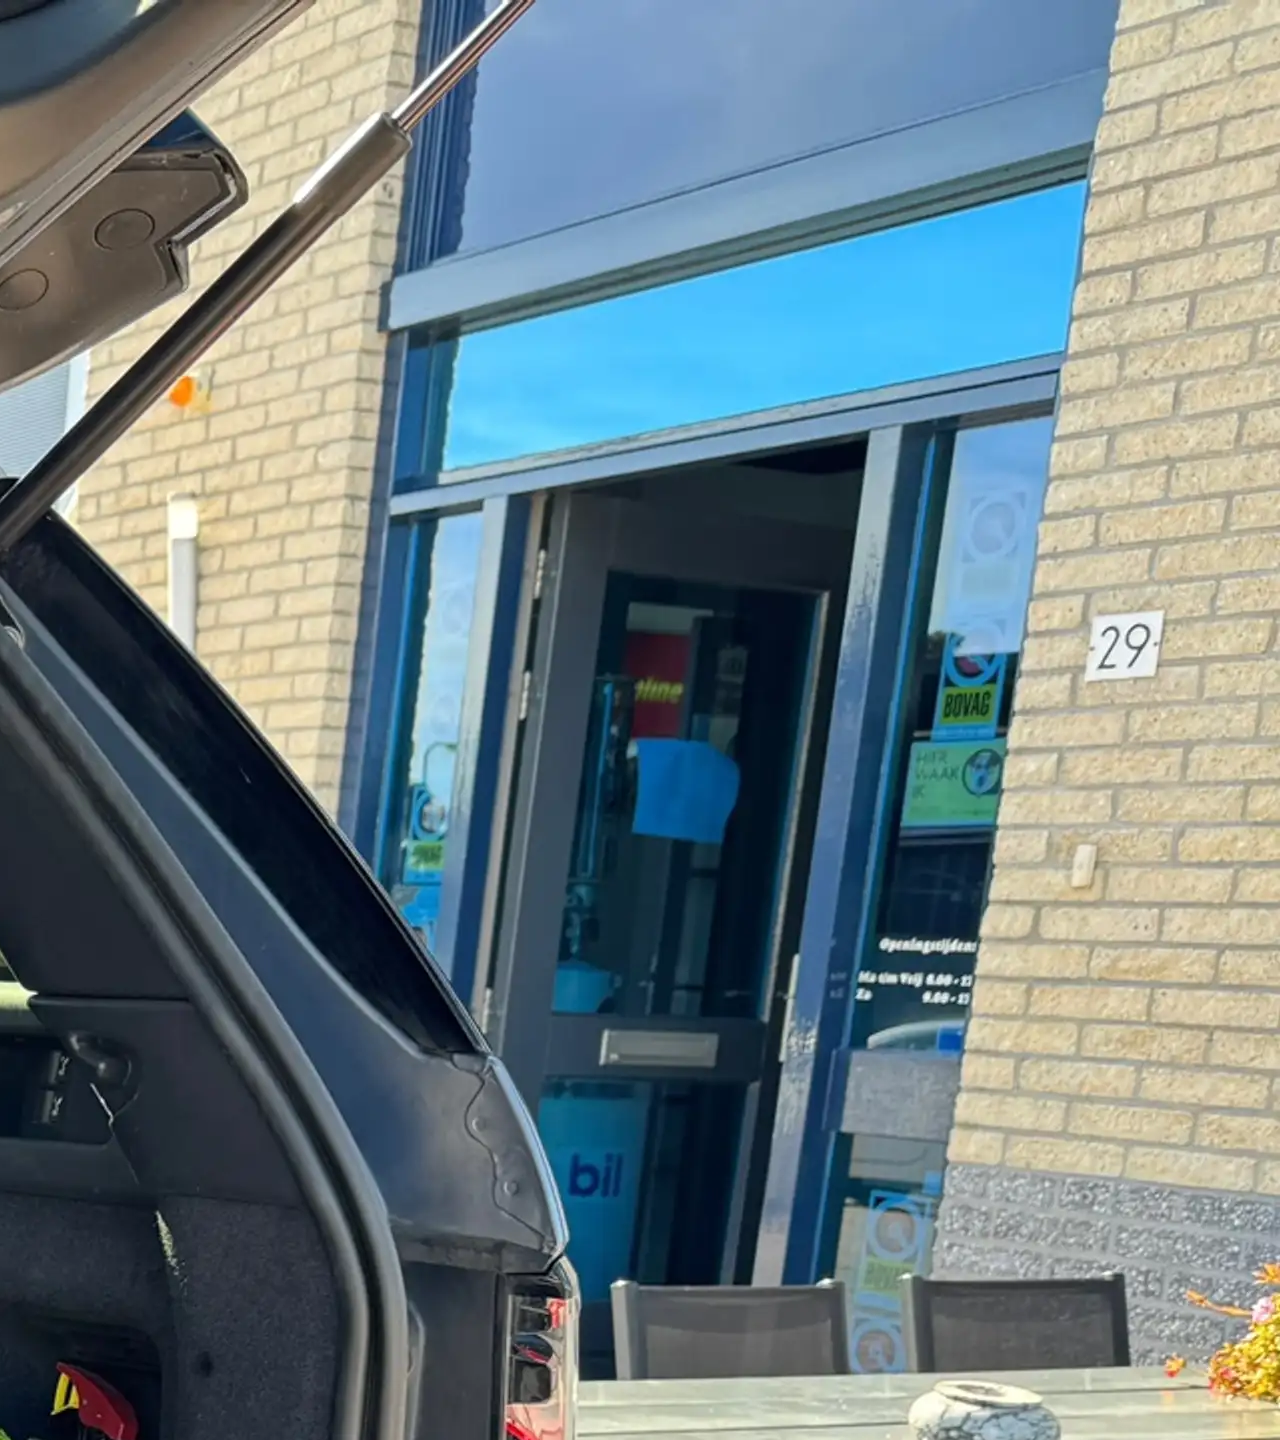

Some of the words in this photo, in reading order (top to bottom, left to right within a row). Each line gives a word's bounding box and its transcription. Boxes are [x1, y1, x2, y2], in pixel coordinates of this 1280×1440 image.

[1097, 622, 1151, 670] 29
[943, 690, 992, 720] BOVAG
[568, 1152, 625, 1198] bil
